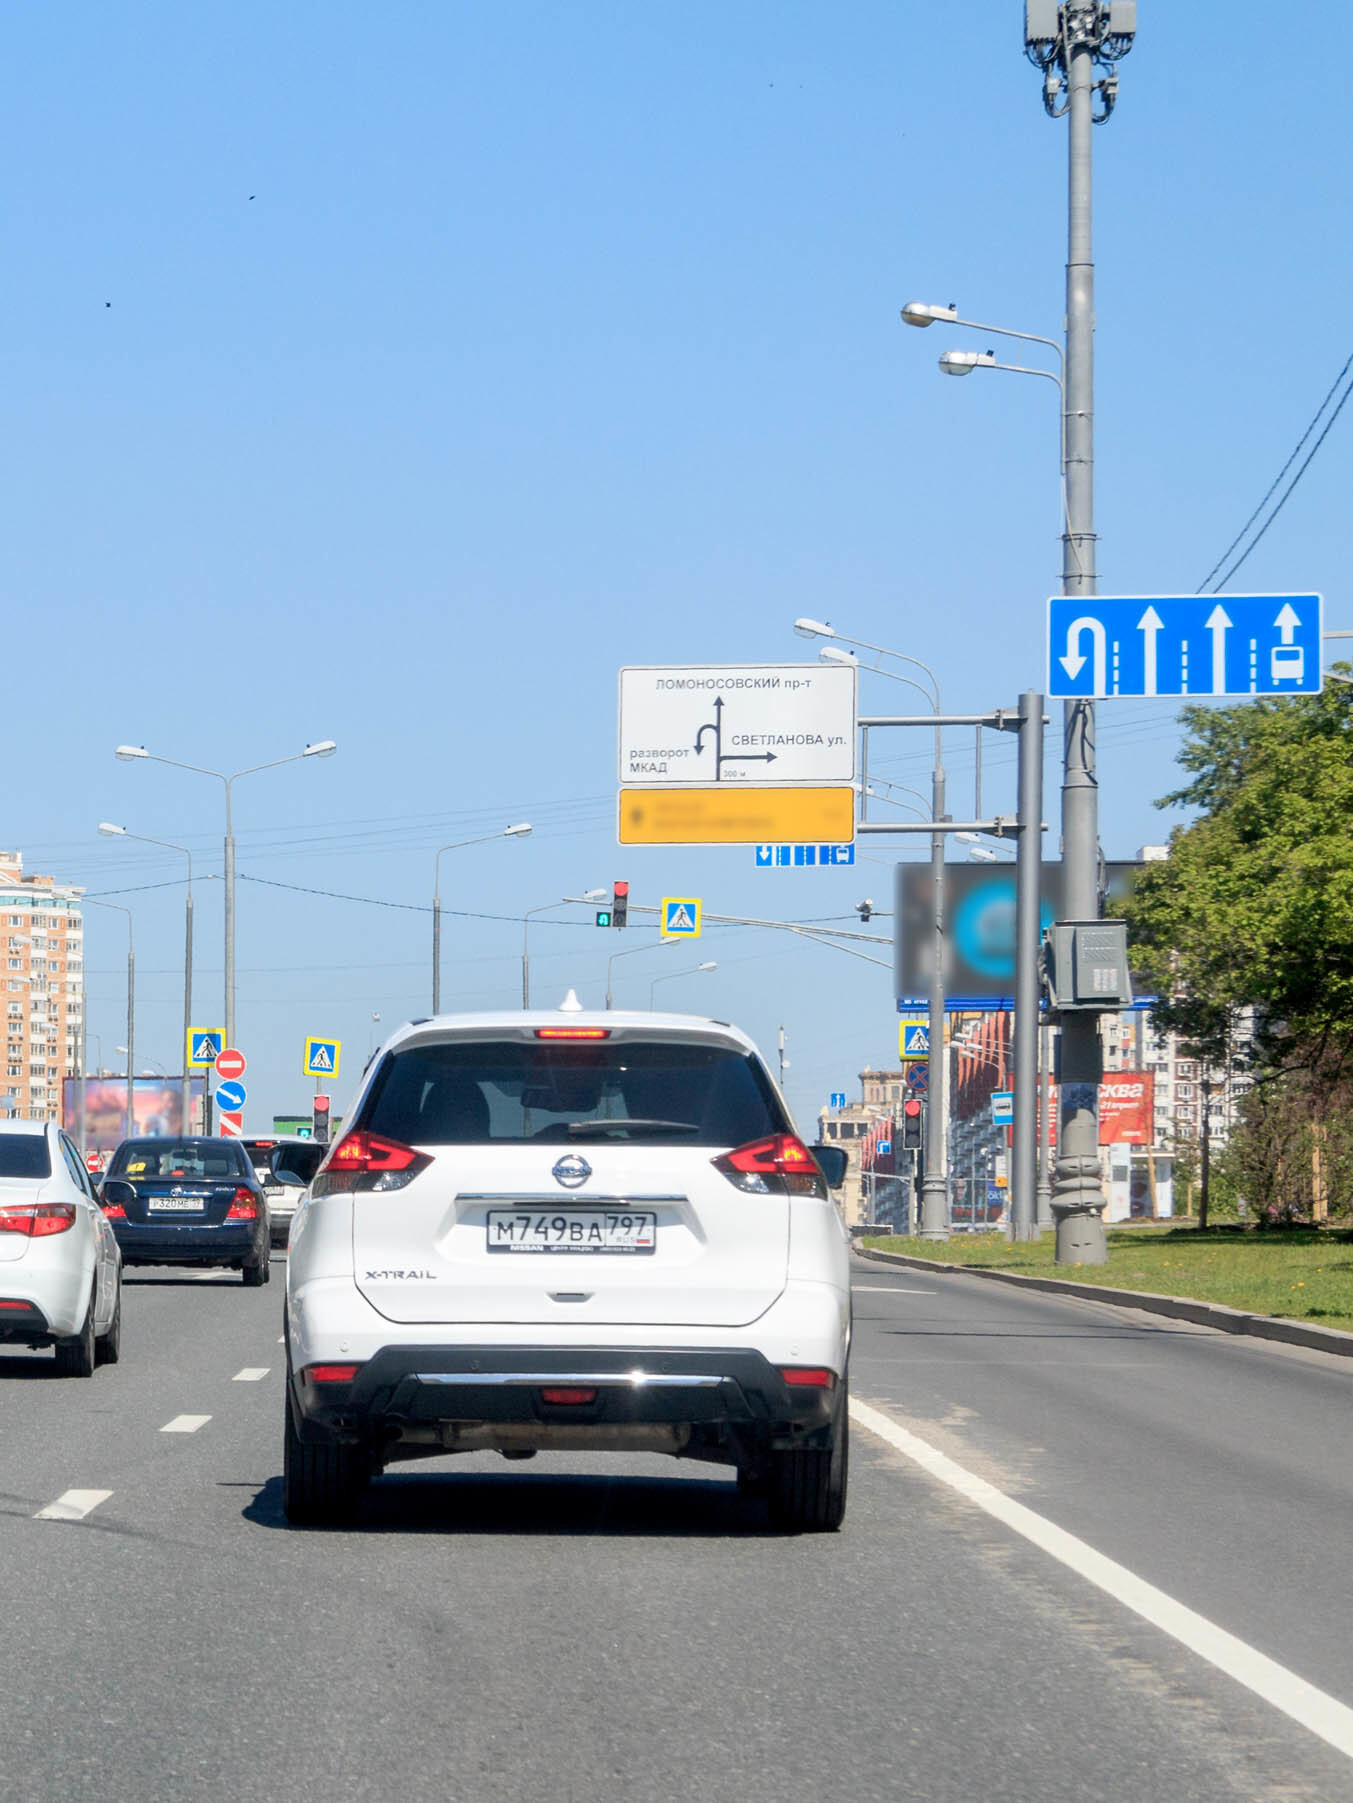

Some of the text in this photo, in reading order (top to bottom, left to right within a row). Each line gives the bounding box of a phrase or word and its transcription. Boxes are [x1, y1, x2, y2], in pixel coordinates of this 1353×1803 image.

[655, 677, 812, 690] ЛОМОНОСОВСКИЙ пр-т
[731, 734, 847, 747] СВЕТЛАНОВА ул.
[630, 749, 690, 760] разворот
[630, 762, 668, 773] МКАД
[497, 1216, 647, 1242] М749ВА 797
[365, 1270, 437, 1280] X-TRAIL
